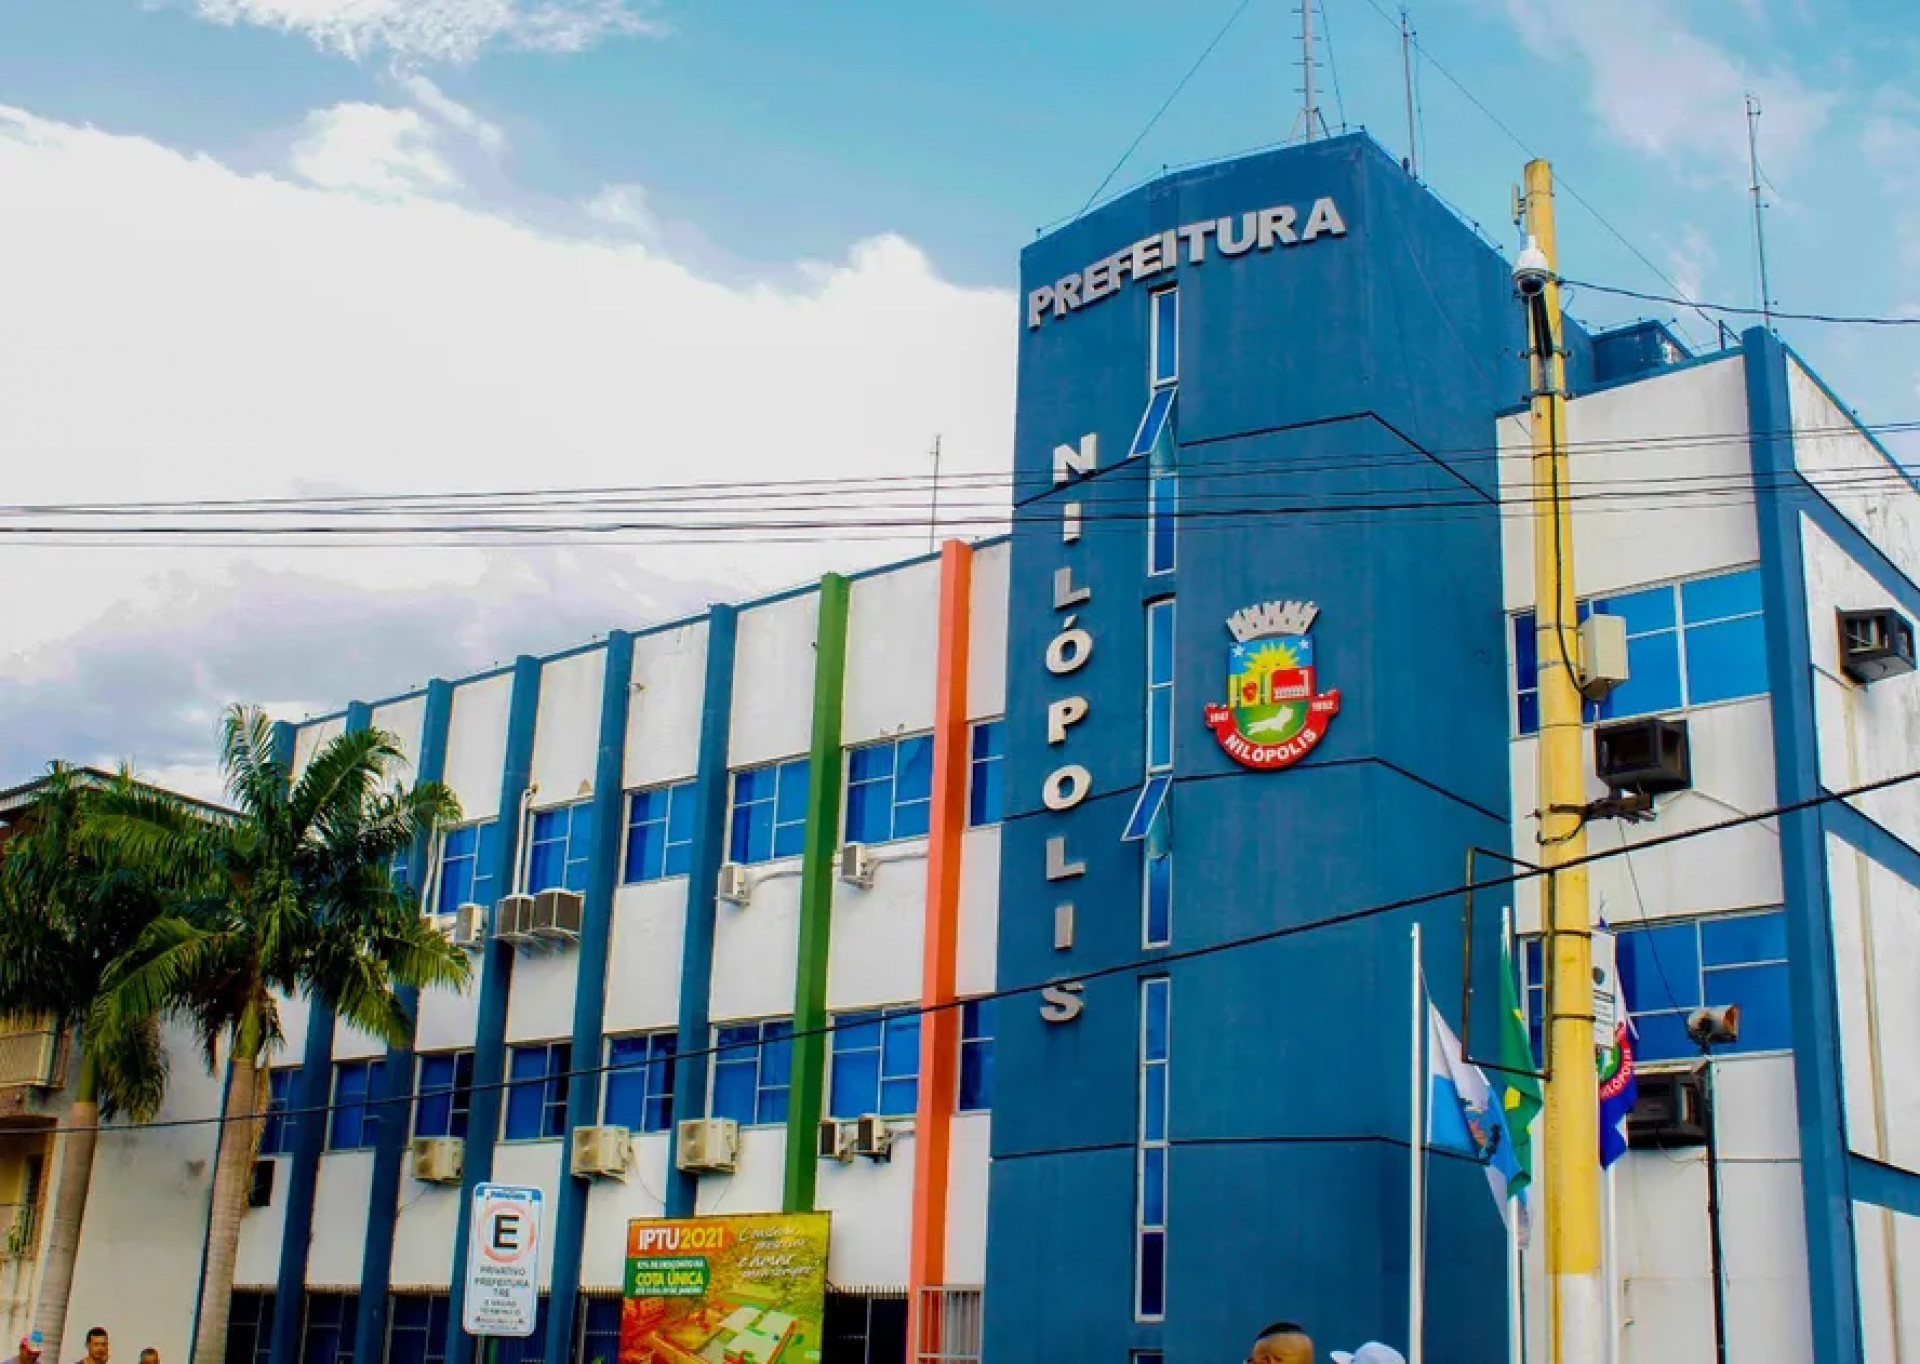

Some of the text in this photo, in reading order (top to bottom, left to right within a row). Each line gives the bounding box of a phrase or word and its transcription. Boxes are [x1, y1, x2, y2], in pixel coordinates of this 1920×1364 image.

[1027, 197, 1347, 330] PREFEITURA
[1039, 432, 1098, 1025] NILÓPOLIS
[1225, 728, 1318, 762] NILÓPOLIS
[493, 1214, 520, 1250] E
